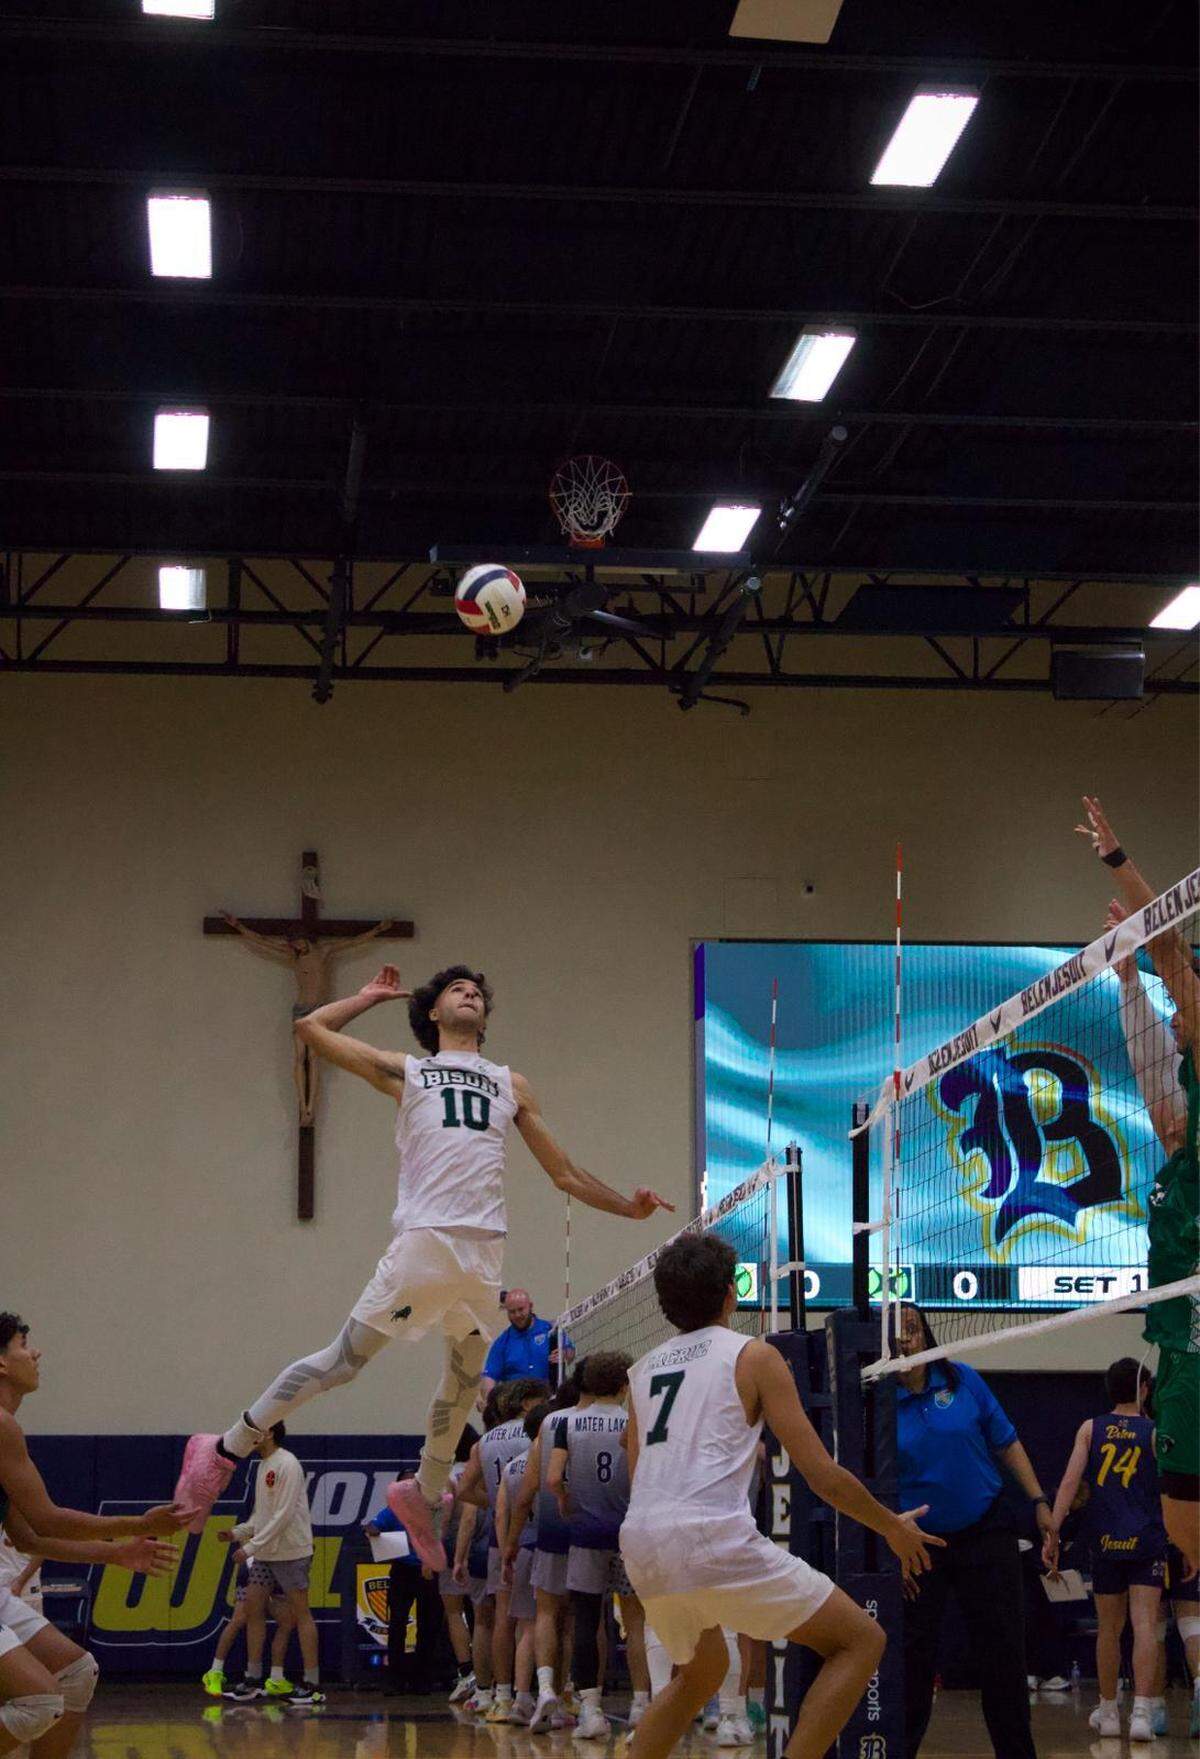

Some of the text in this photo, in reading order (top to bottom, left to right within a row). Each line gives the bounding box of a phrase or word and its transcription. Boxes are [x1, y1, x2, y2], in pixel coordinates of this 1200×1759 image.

[441, 1087, 491, 1131] 10
[953, 1271, 978, 1300] 0
[1054, 1273, 1142, 1293] SET 1
[646, 1369, 686, 1446] 7
[575, 1416, 604, 1432] MATER
[596, 1451, 612, 1483] 8
[1097, 1443, 1142, 1488] 14
